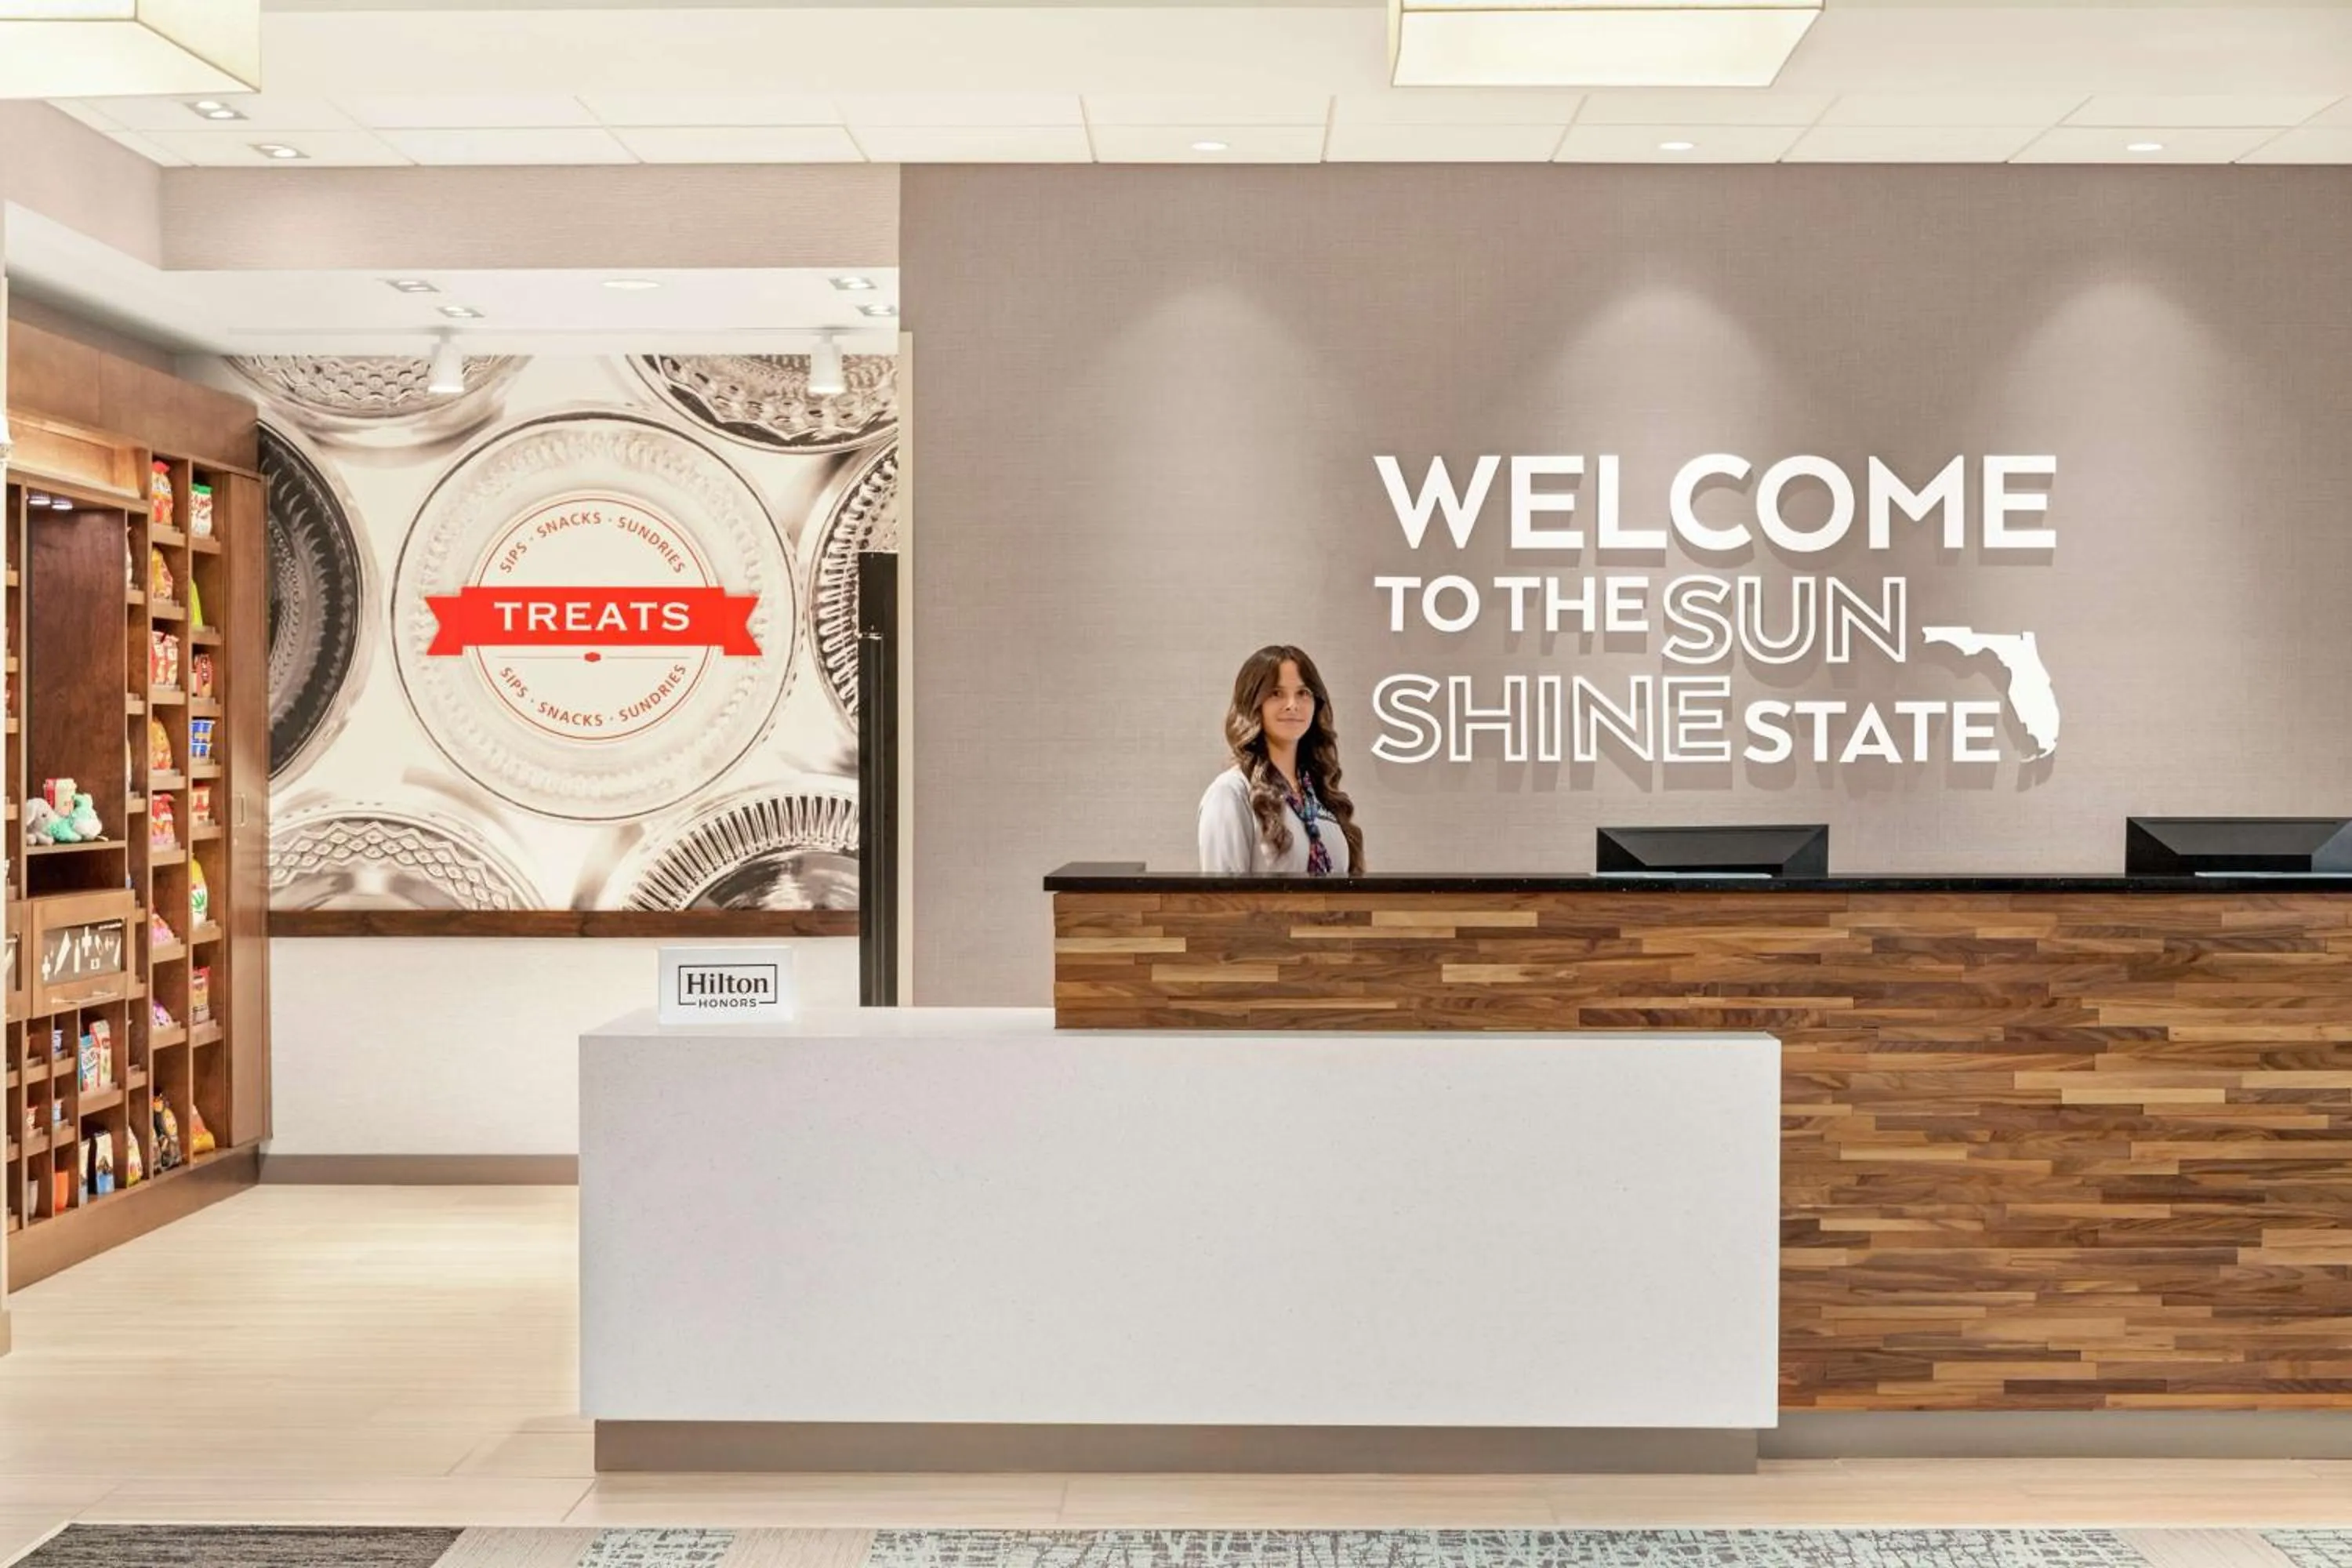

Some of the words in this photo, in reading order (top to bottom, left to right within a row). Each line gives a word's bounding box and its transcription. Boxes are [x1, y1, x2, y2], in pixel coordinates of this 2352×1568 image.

[1374, 453, 2057, 552] WELCOME
[499, 541, 528, 573] SIPS
[536, 511, 602, 539] SNACKS
[617, 516, 686, 574] SUNDRIES
[493, 601, 691, 632] TREATS
[1374, 575, 1480, 633] TO
[1494, 575, 1650, 632] THE
[1661, 574, 1907, 664] SUN
[500, 666, 528, 699] SIPS
[538, 702, 604, 727] SNACKS
[619, 663, 687, 723] SUNDRIES
[1370, 673, 1732, 764] SHINE
[1743, 699, 2001, 764] STATE
[686, 972, 769, 995] Hilton
[698, 998, 757, 1009] HONORS
